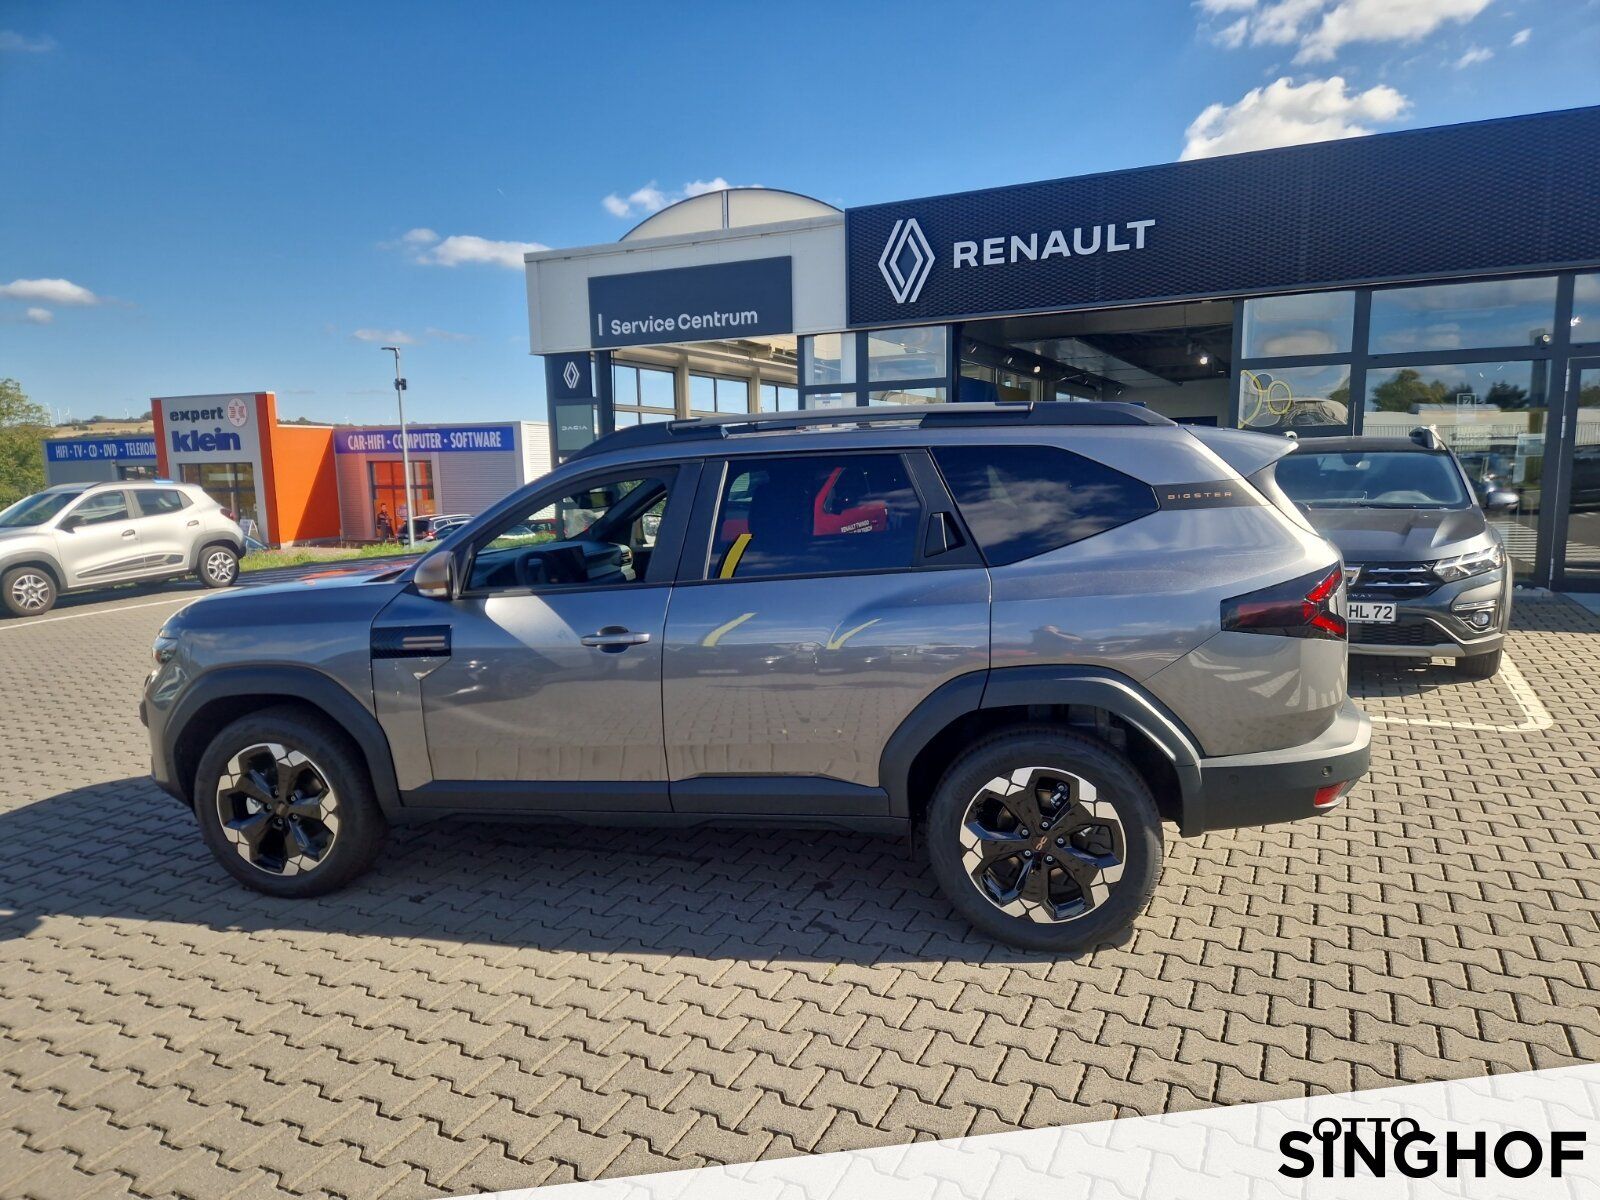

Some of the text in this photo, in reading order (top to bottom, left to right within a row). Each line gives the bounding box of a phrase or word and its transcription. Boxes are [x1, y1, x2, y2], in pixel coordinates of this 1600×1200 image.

[953, 219, 1156, 269] RENAULT
[611, 310, 758, 335] Service Centrum
[169, 406, 224, 422] expert
[171, 427, 242, 452] klein
[347, 434, 385, 450] CAR-HIFI
[450, 431, 502, 448] SOFTWARE
[55, 445, 69, 458] HIFI
[73, 444, 83, 458] TV
[88, 444, 98, 457] CD
[103, 443, 118, 457] DVD
[1167, 491, 1233, 500] BIGSTER
[1349, 605, 1393, 620] HL 72
